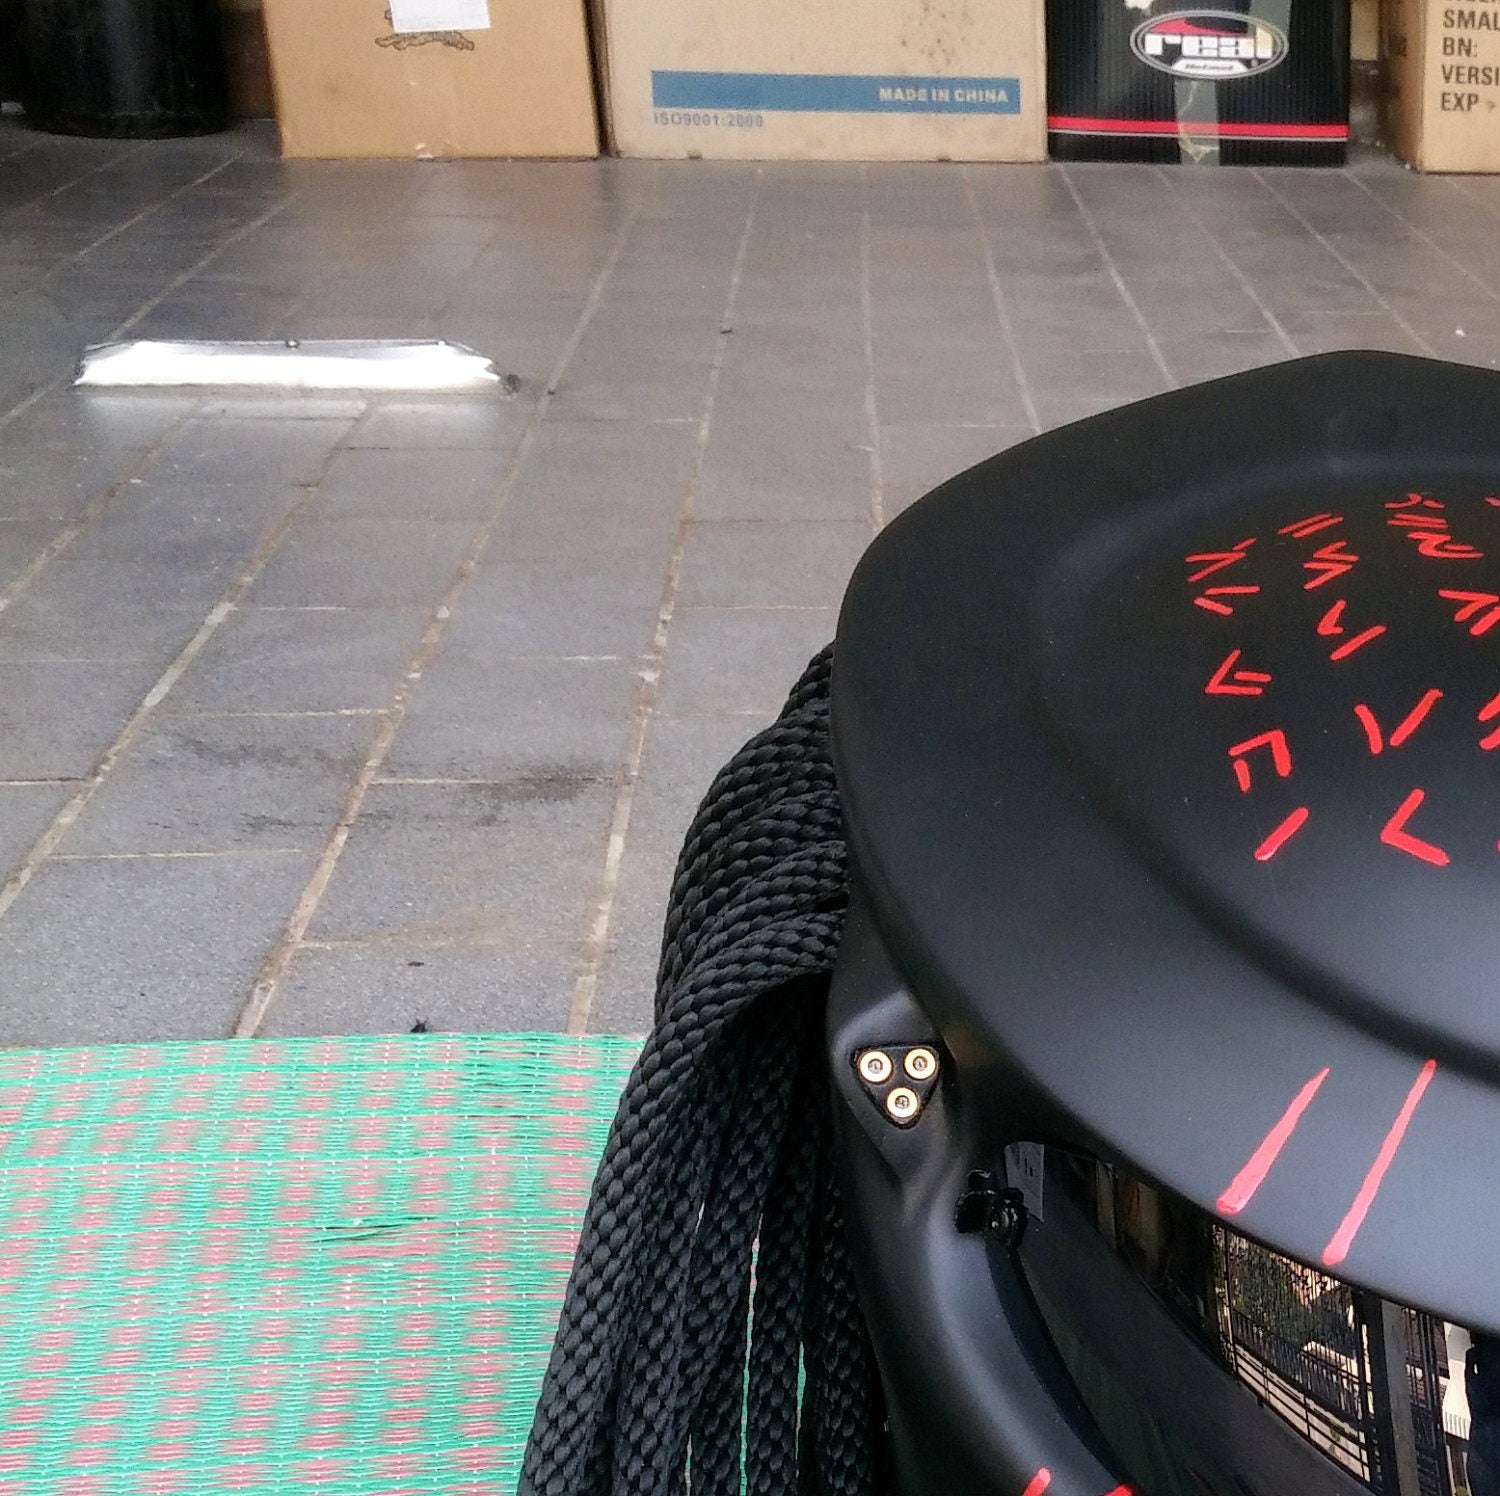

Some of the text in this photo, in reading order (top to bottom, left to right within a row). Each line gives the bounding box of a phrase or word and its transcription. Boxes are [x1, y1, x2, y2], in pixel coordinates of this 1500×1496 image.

[1442, 37, 1478, 58] BN:
[878, 87, 1009, 104] MADE IN CHINA
[1440, 91, 1479, 112] EXP
